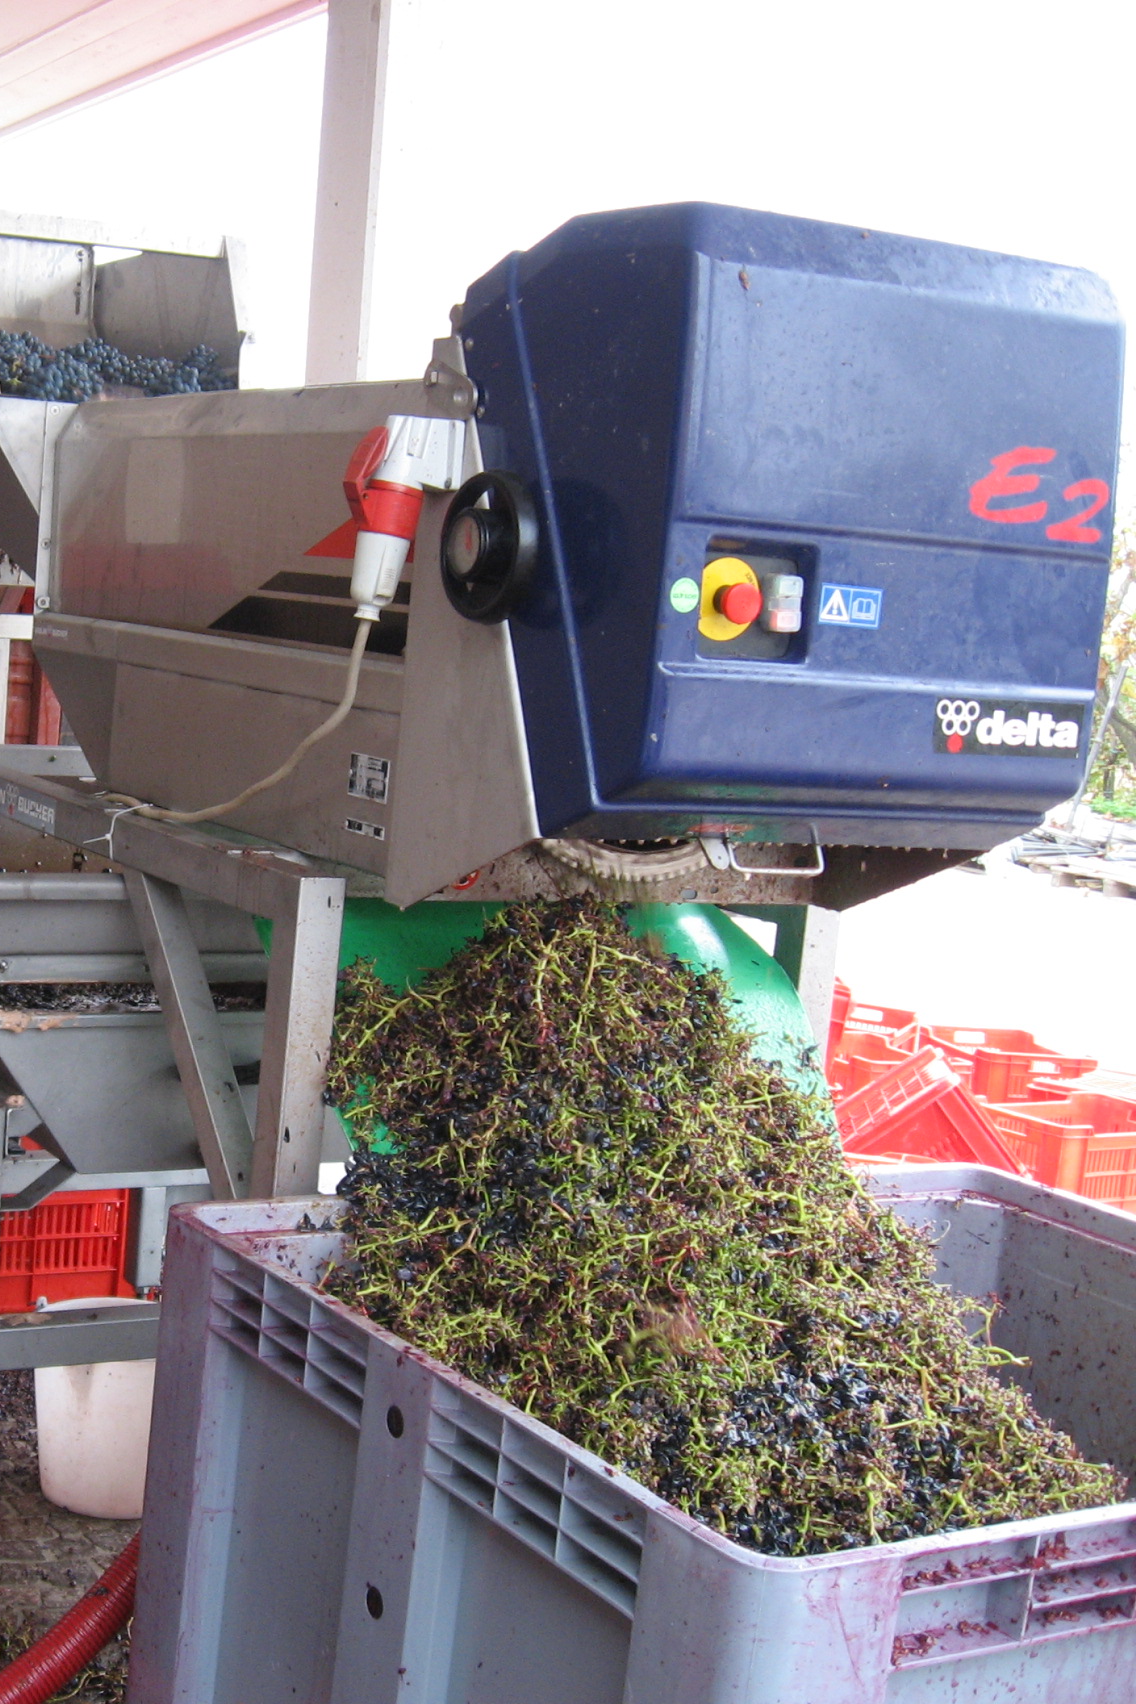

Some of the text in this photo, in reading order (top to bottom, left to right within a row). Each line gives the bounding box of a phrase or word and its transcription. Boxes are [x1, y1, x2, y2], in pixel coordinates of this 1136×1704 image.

[969, 446, 1110, 543] E2
[975, 709, 1079, 748] delta
[17, 795, 55, 824] BUCHER
